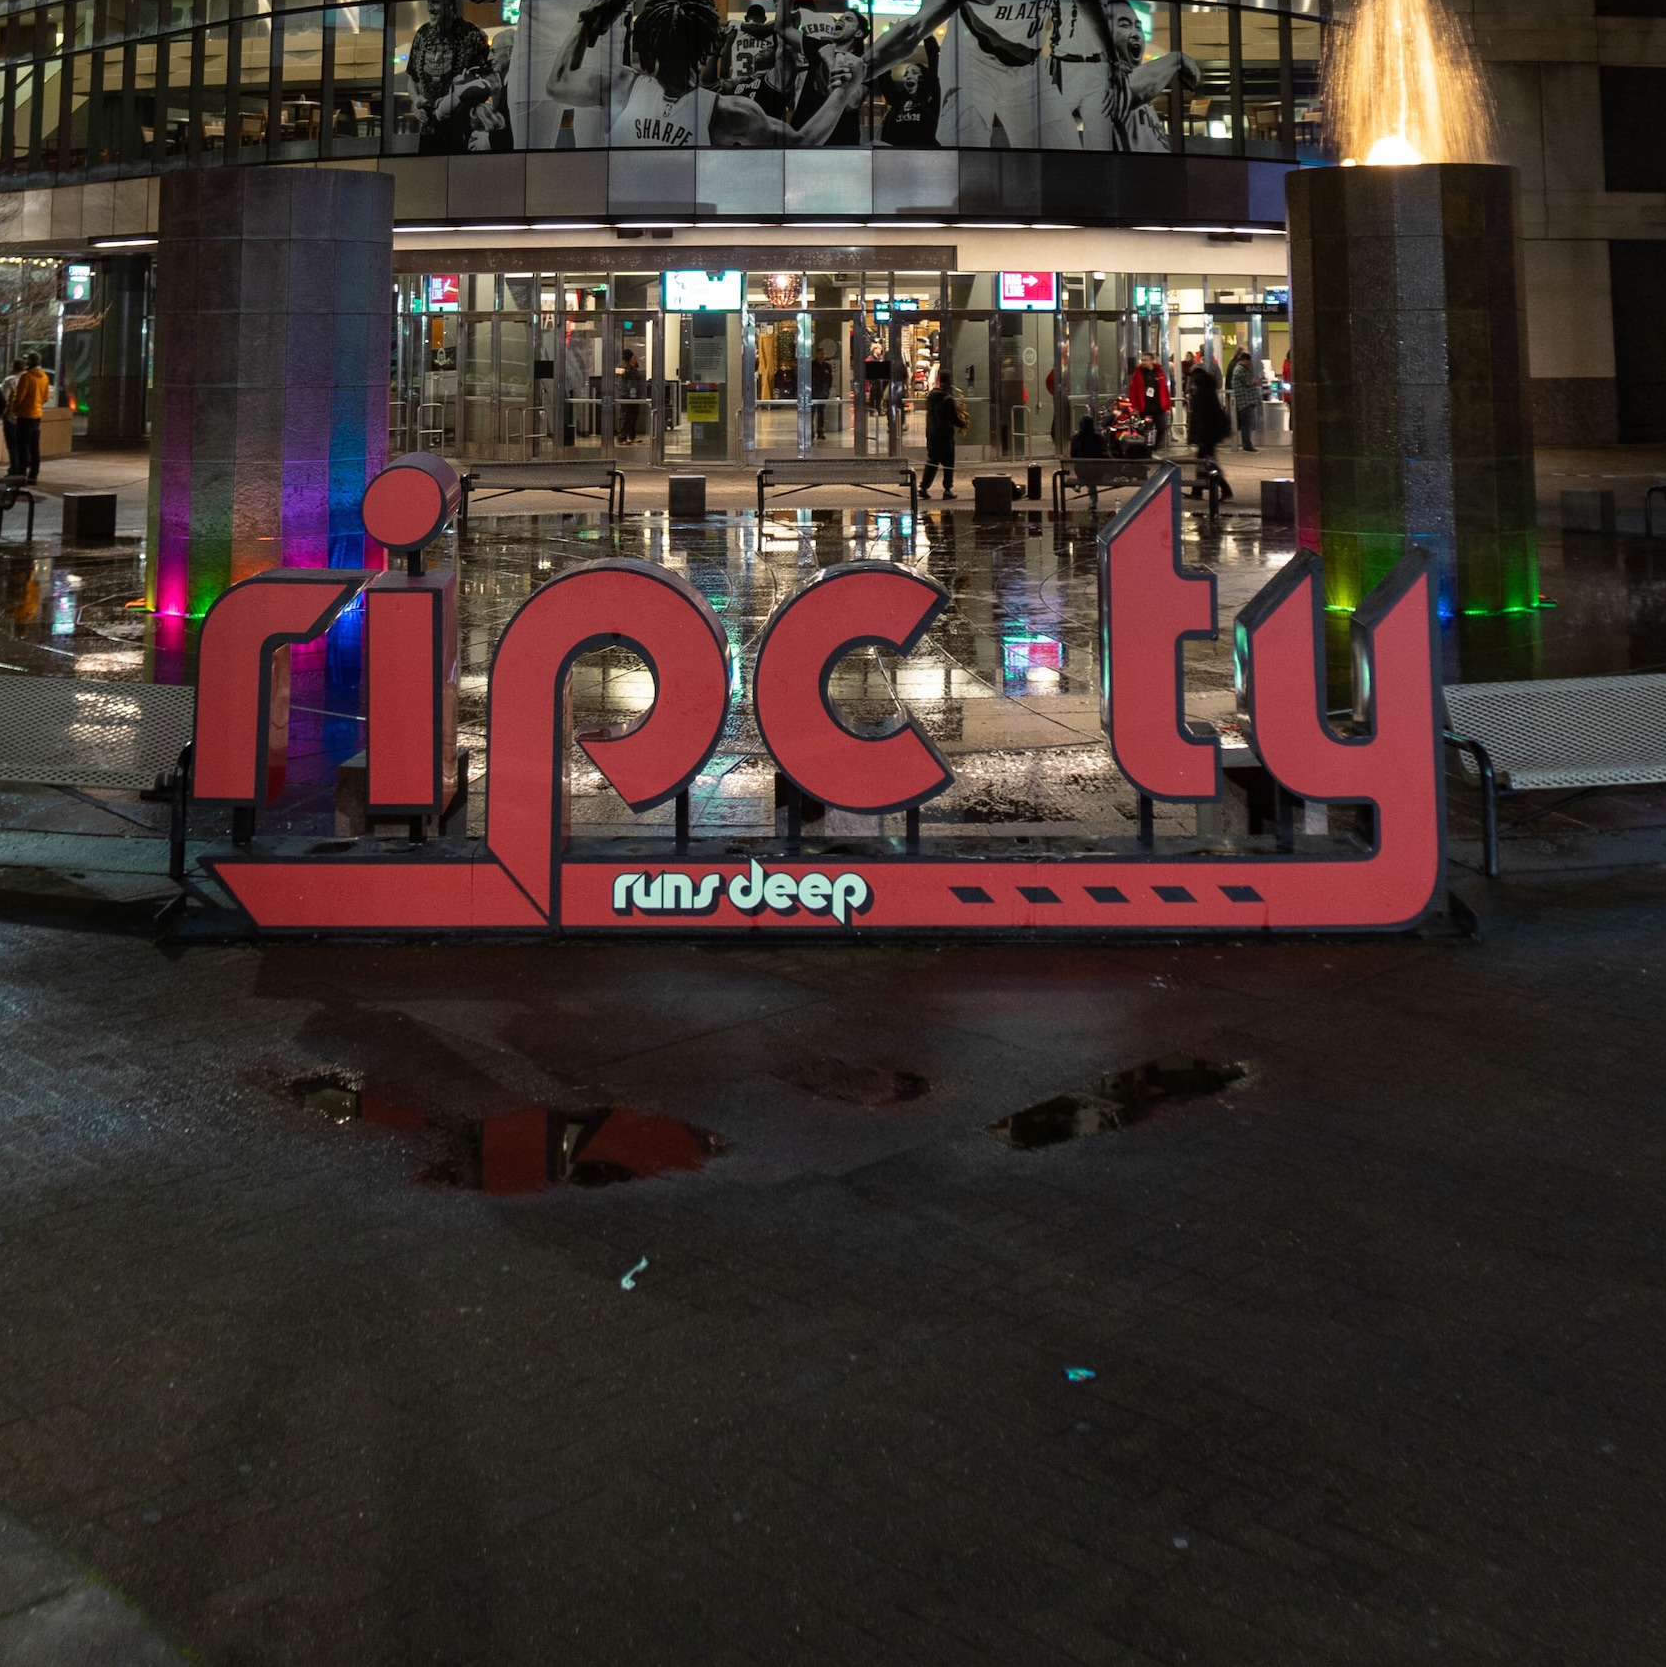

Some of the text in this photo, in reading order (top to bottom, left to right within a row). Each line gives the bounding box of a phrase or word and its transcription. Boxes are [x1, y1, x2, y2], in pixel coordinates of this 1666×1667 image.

[736, 37, 773, 52] PORTE
[634, 118, 694, 147] SHARPE
[1245, 304, 1279, 313] BAG LINE
[613, 857, 870, 925] runs deep
